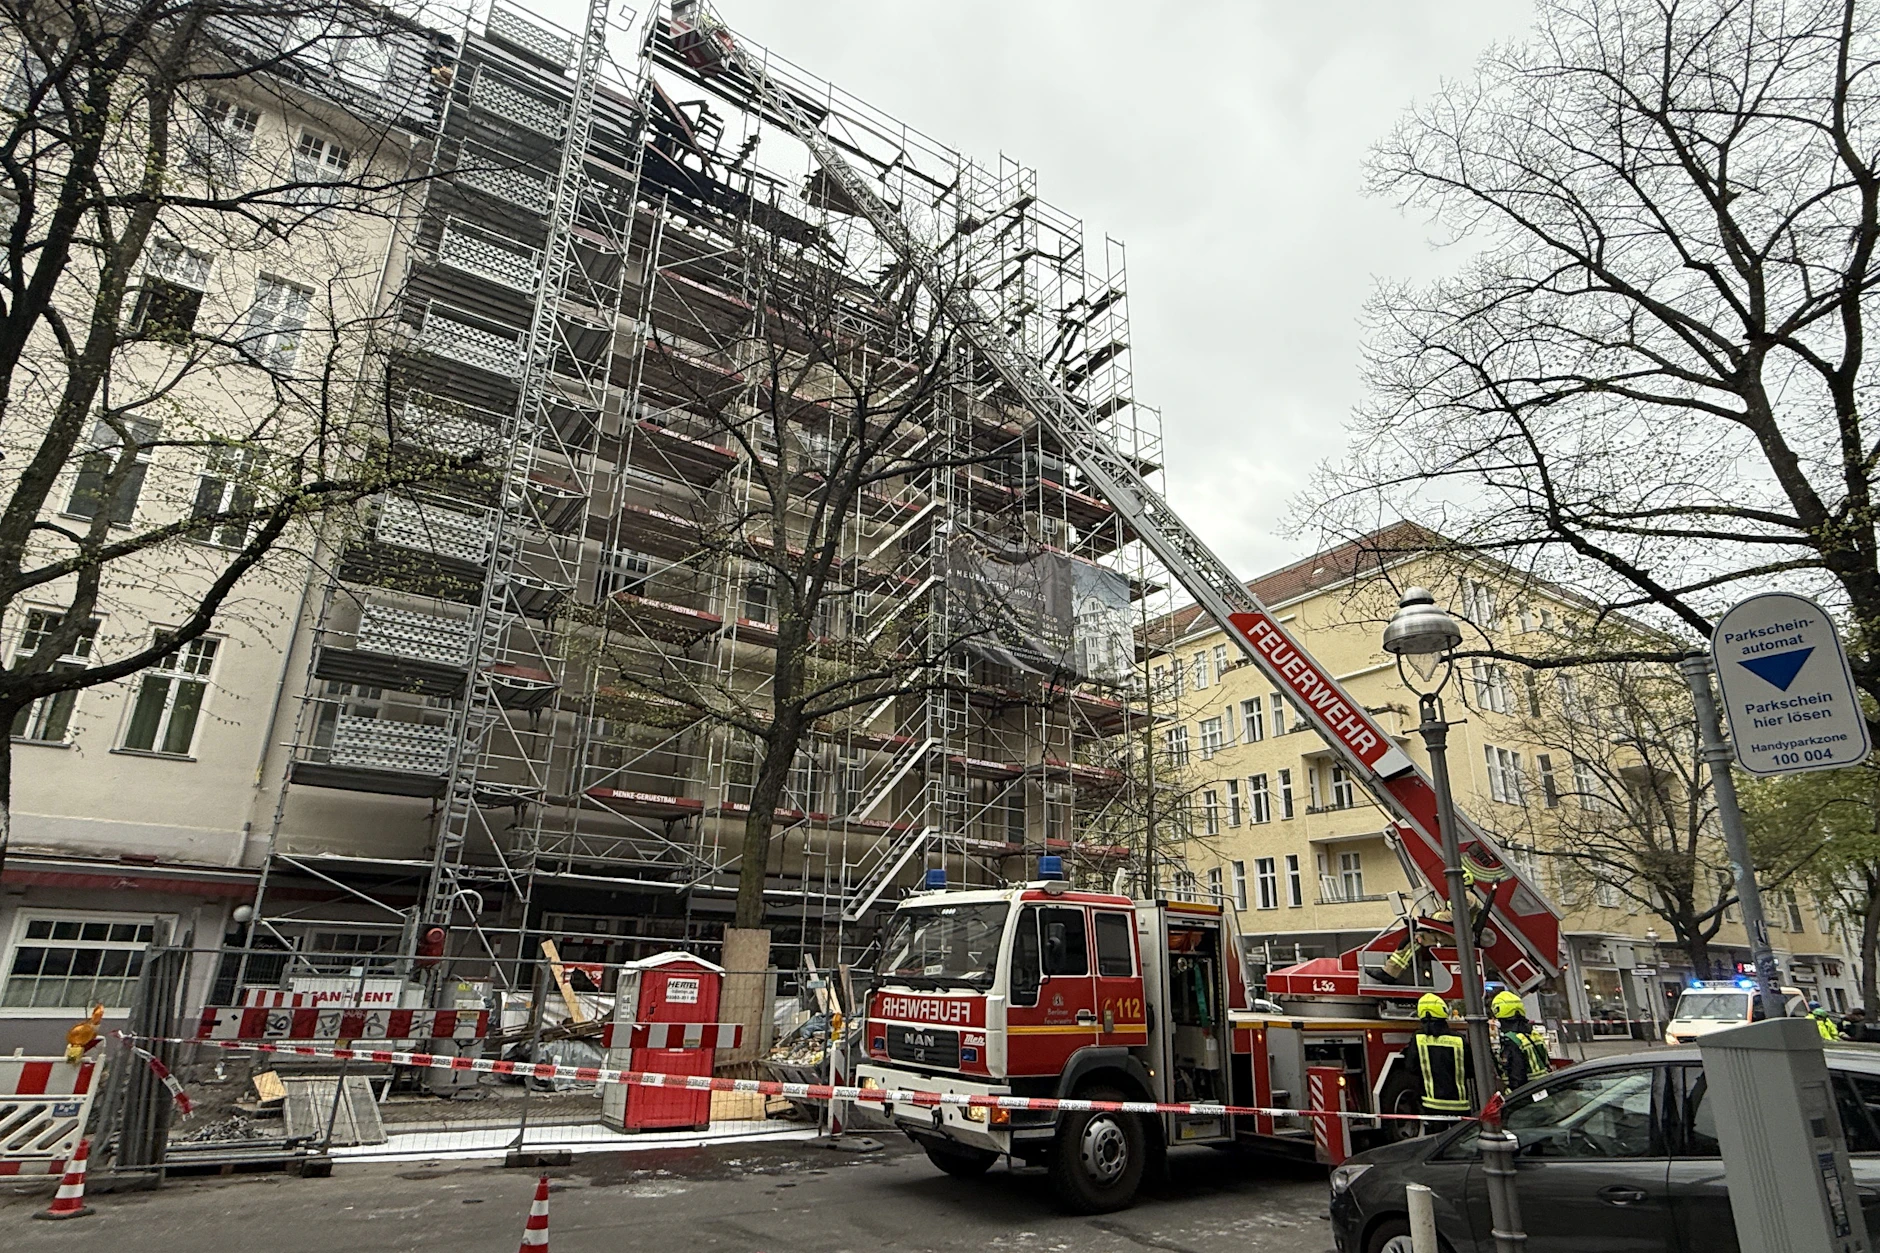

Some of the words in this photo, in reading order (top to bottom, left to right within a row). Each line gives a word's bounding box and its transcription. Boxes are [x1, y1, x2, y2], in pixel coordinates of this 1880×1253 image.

[1725, 619, 1814, 644] Parkschein-
[1742, 634, 1804, 654] automat
[1247, 620, 1377, 755] FEUERWEHR
[1745, 693, 1832, 714] Parkschein
[1753, 716, 1783, 728] hier
[1788, 708, 1831, 723] lösen
[1751, 733, 1847, 753] Handyparkzone
[1773, 754, 1799, 765] 100
[1805, 748, 1833, 761] 004
[612, 790, 676, 804] MENKE-GERUESTBAU
[668, 980, 698, 989] HERTEL
[1313, 979, 1335, 992] L32
[1048, 1008, 1068, 1016] Berliner
[1117, 998, 1140, 1018] 112
[905, 1033, 935, 1046] MAN
